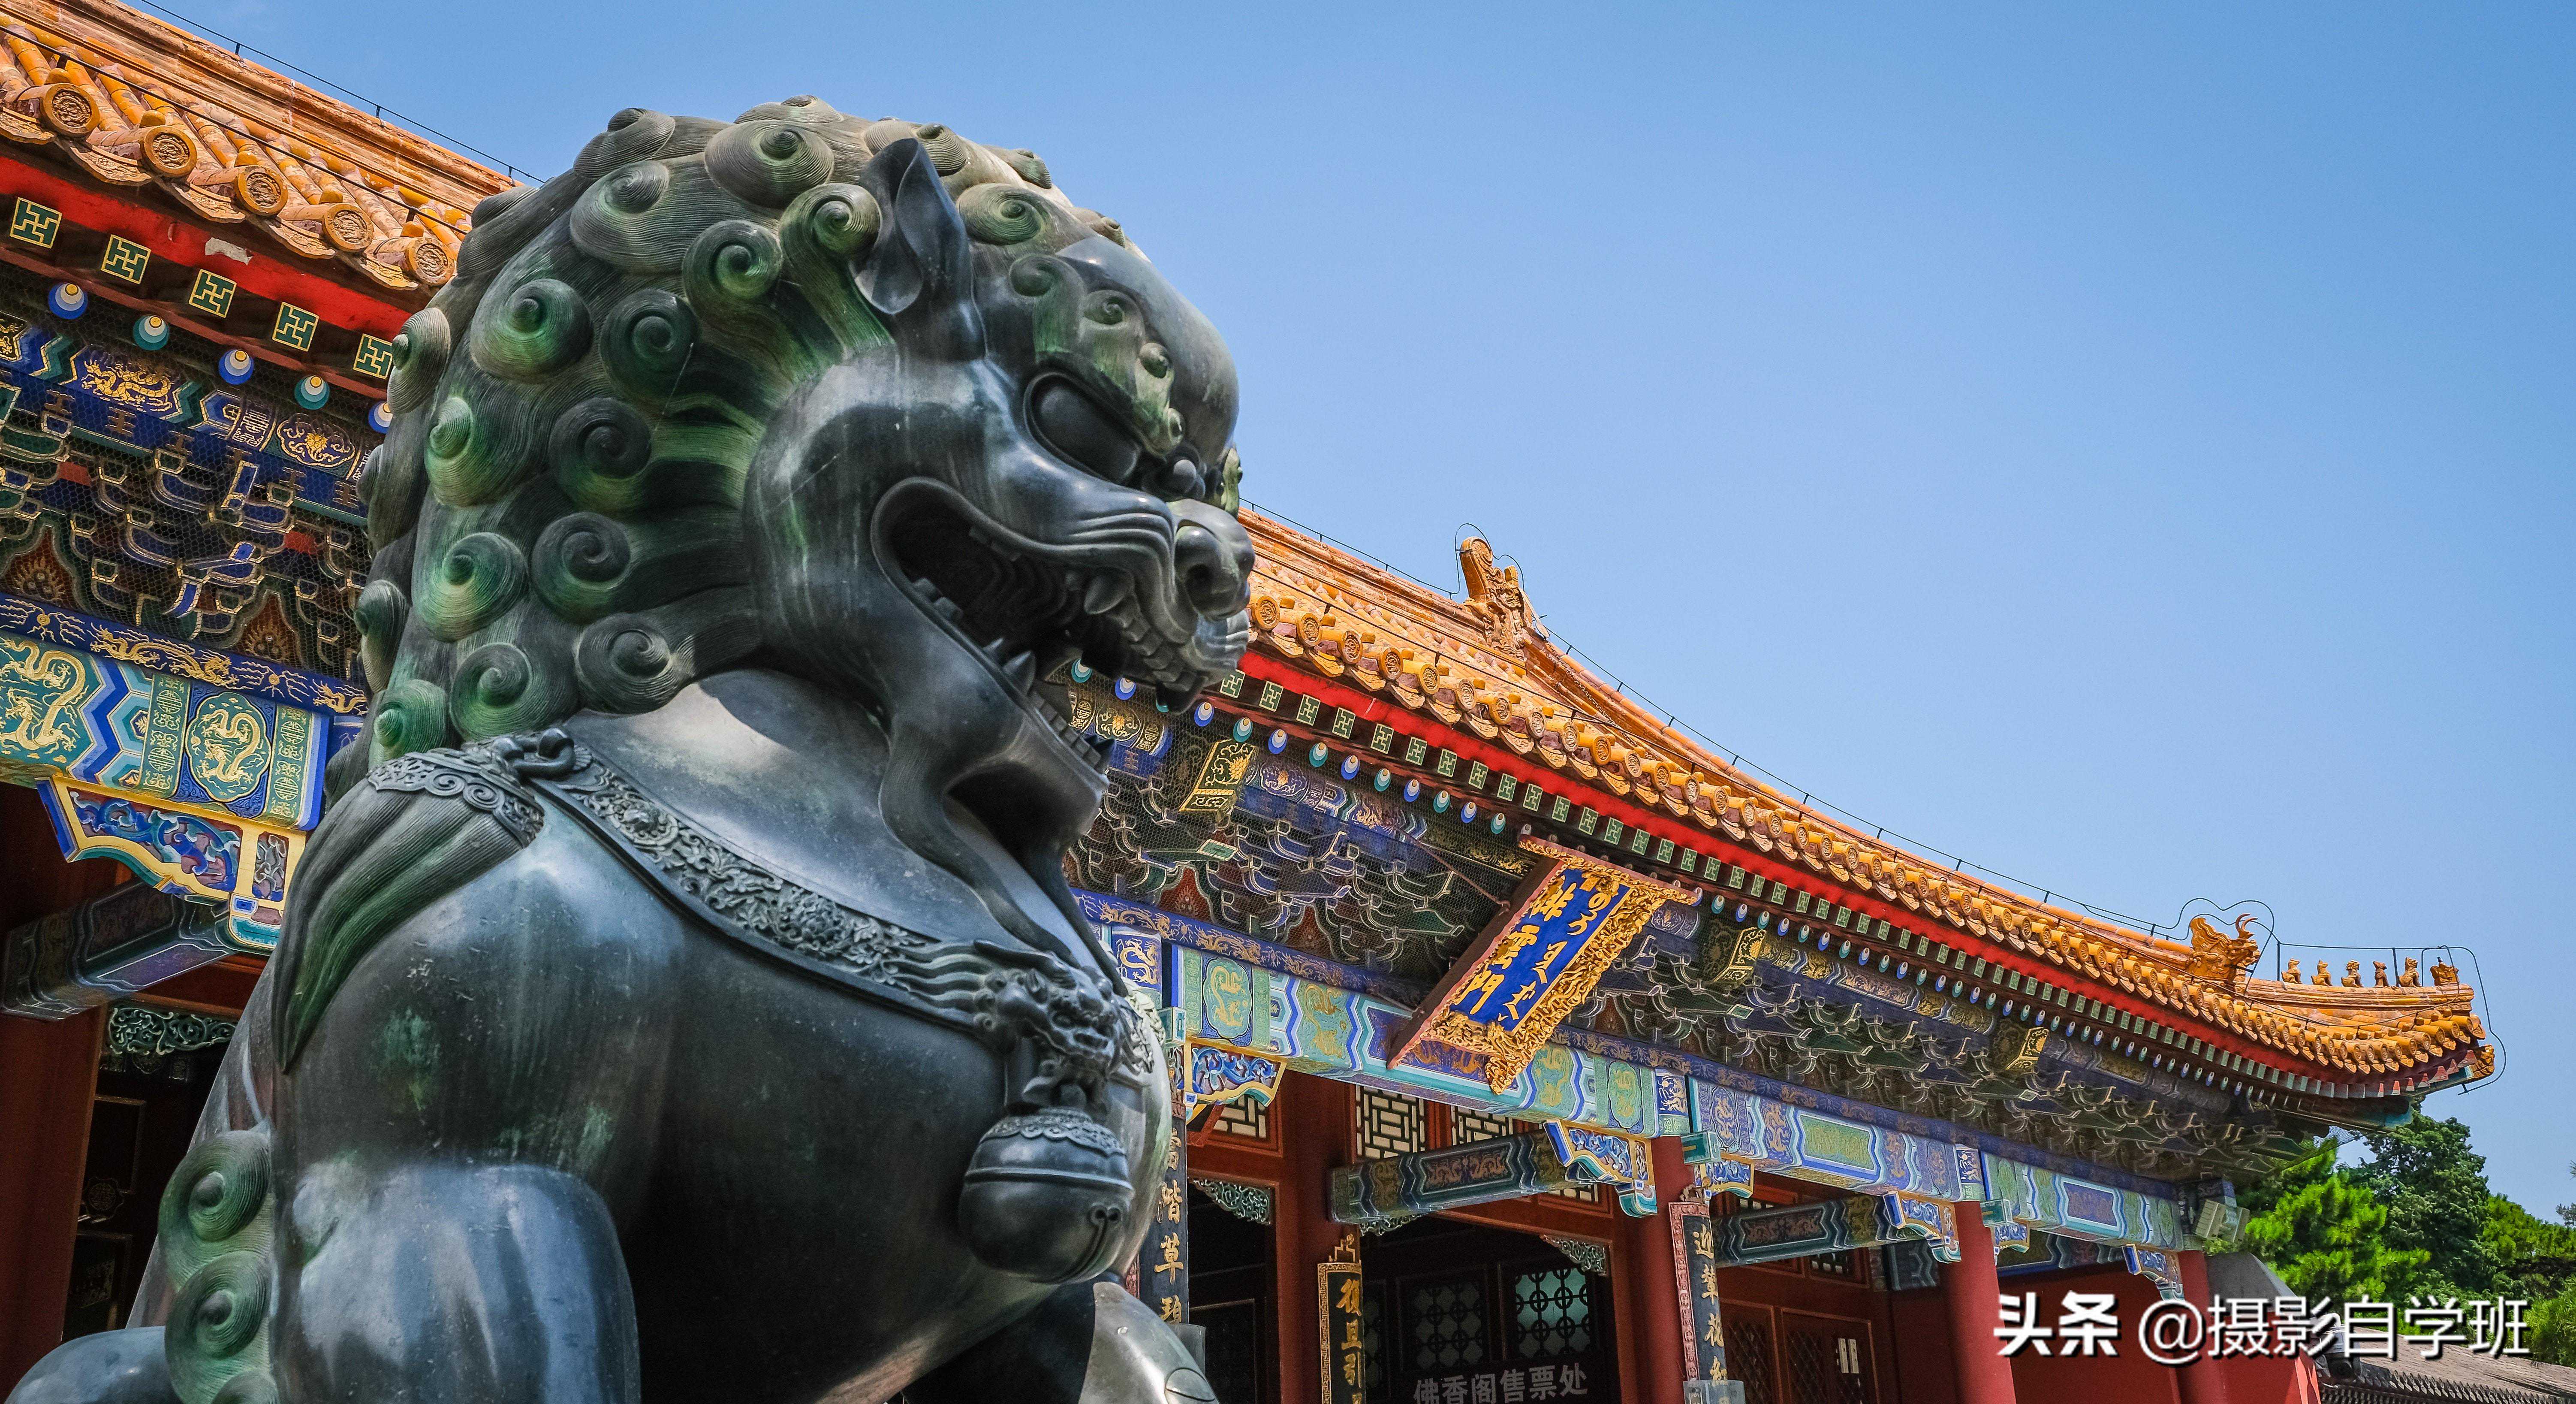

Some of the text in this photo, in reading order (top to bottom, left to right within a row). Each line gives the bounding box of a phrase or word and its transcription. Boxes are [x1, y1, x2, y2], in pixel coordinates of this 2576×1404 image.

[1336, 1278, 1362, 1404] 復旦引
[1693, 1224, 1729, 1404] 迎輦花紅
[1414, 1362, 1588, 1404] 佛香阁售票处
